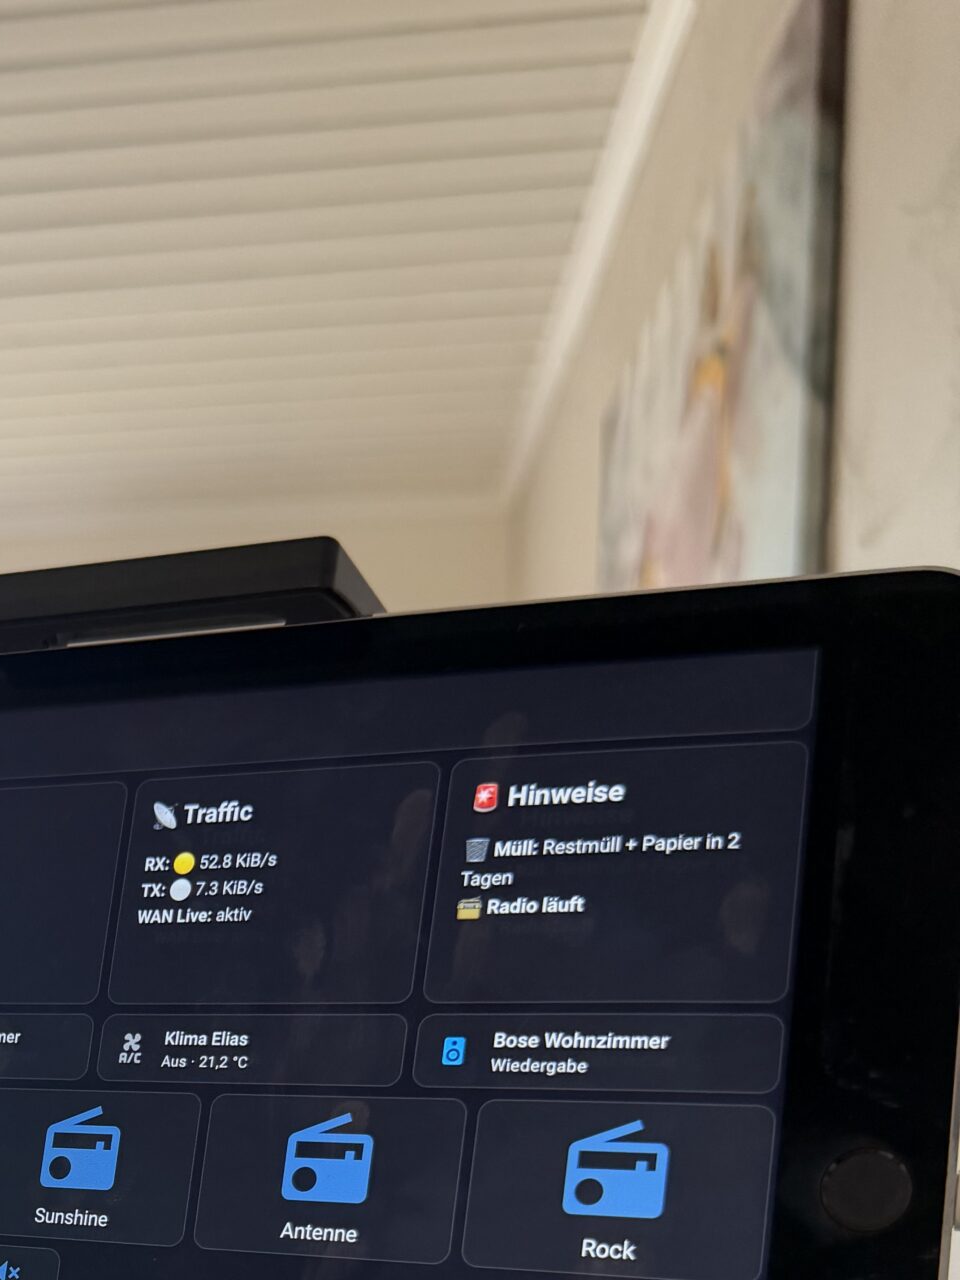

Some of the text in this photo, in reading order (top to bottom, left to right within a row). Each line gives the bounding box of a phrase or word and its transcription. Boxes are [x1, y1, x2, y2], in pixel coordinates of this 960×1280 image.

[507, 780, 626, 807] Hinweise
[184, 800, 254, 825] Traffic
[493, 832, 741, 857] Müll: Restmüll + Papier in 2
[144, 852, 277, 872] RX: 52.8 KiB/s
[141, 880, 263, 898] TX: 7.3 KiB/s
[461, 870, 514, 889] Tagen
[486, 895, 586, 915] Radio läuft
[138, 907, 252, 924] WAN Live: aktiv
[164, 1031, 249, 1047] Klima Elias
[493, 1032, 670, 1050] Bose Wohnzimmer
[161, 1055, 249, 1070] Aus 21,2 °C
[490, 1058, 588, 1076] Wiedergabe
[34, 1207, 109, 1228] Sunshine
[280, 1221, 358, 1244] Antenne
[581, 1238, 637, 1261] Rock
